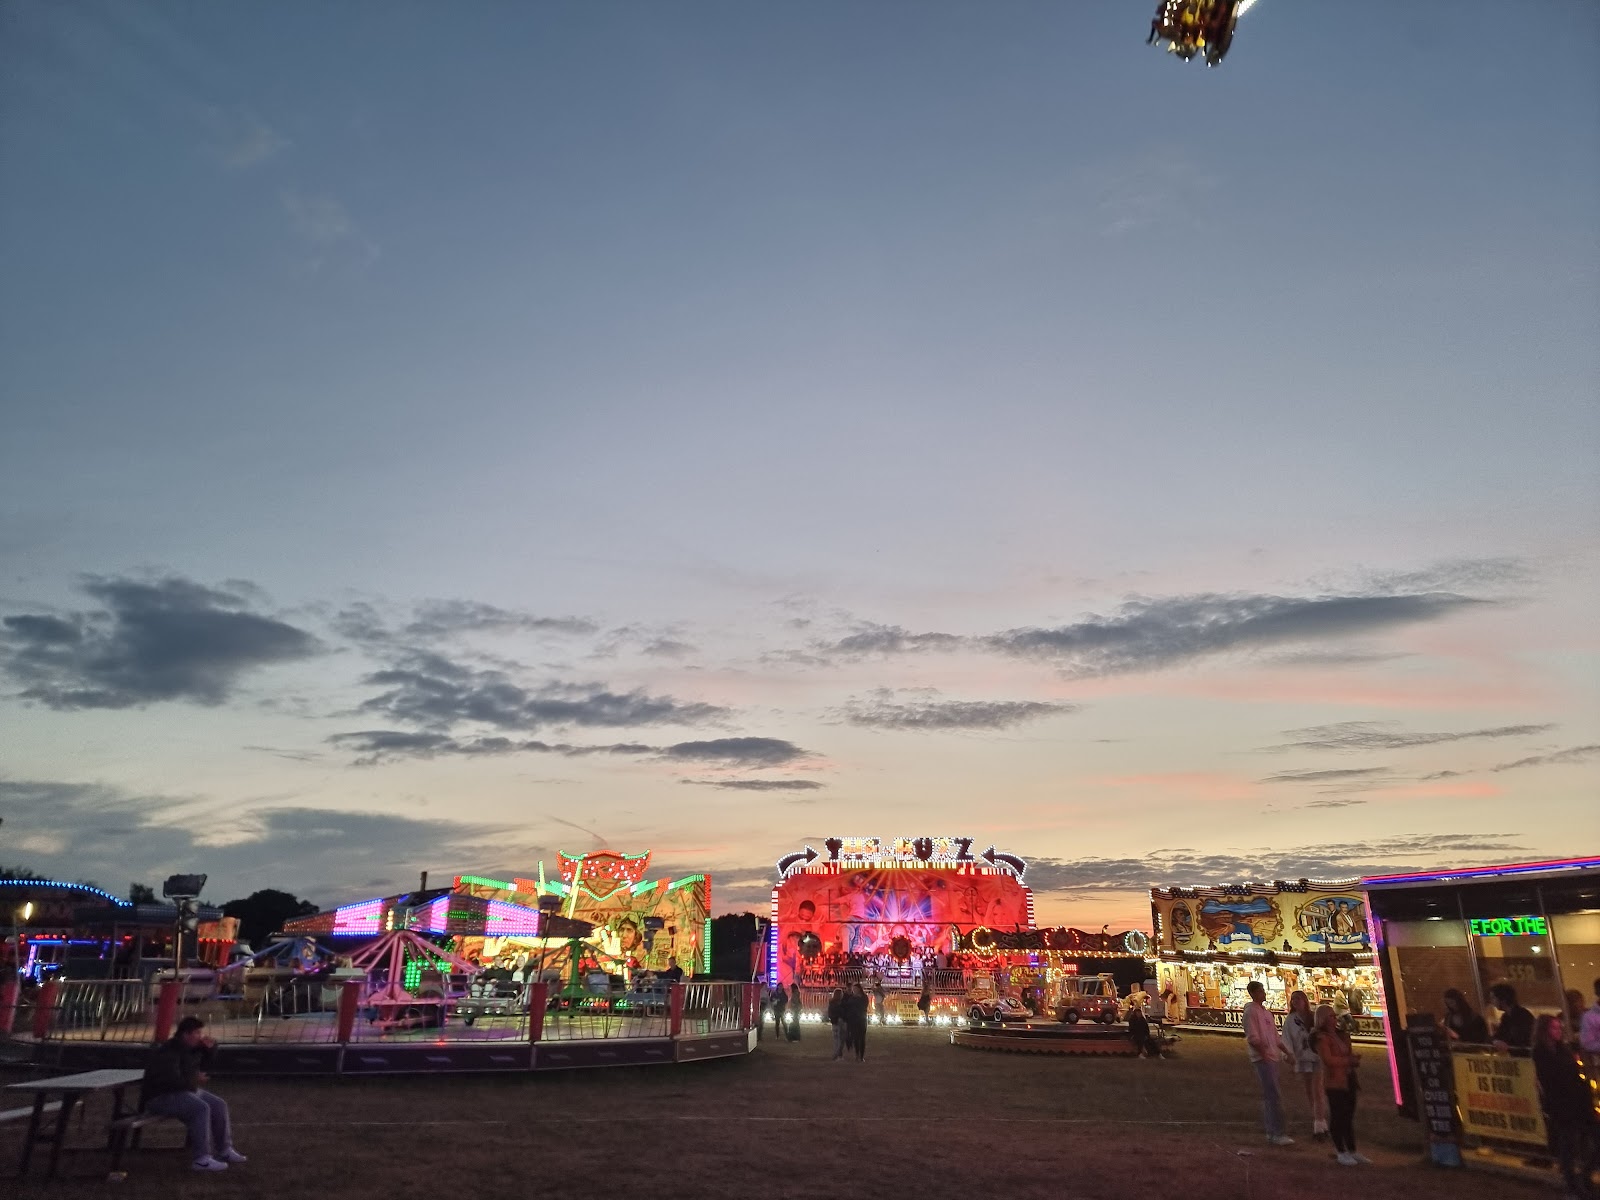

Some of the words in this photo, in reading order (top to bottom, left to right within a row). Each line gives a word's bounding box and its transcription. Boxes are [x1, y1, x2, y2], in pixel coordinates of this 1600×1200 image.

[1482, 919, 1513, 935] FOR
[1516, 918, 1547, 935] THE
[1466, 1058, 1492, 1074] THIS
[1477, 1076, 1490, 1092] IS
[1424, 1091, 1448, 1101] OVER
